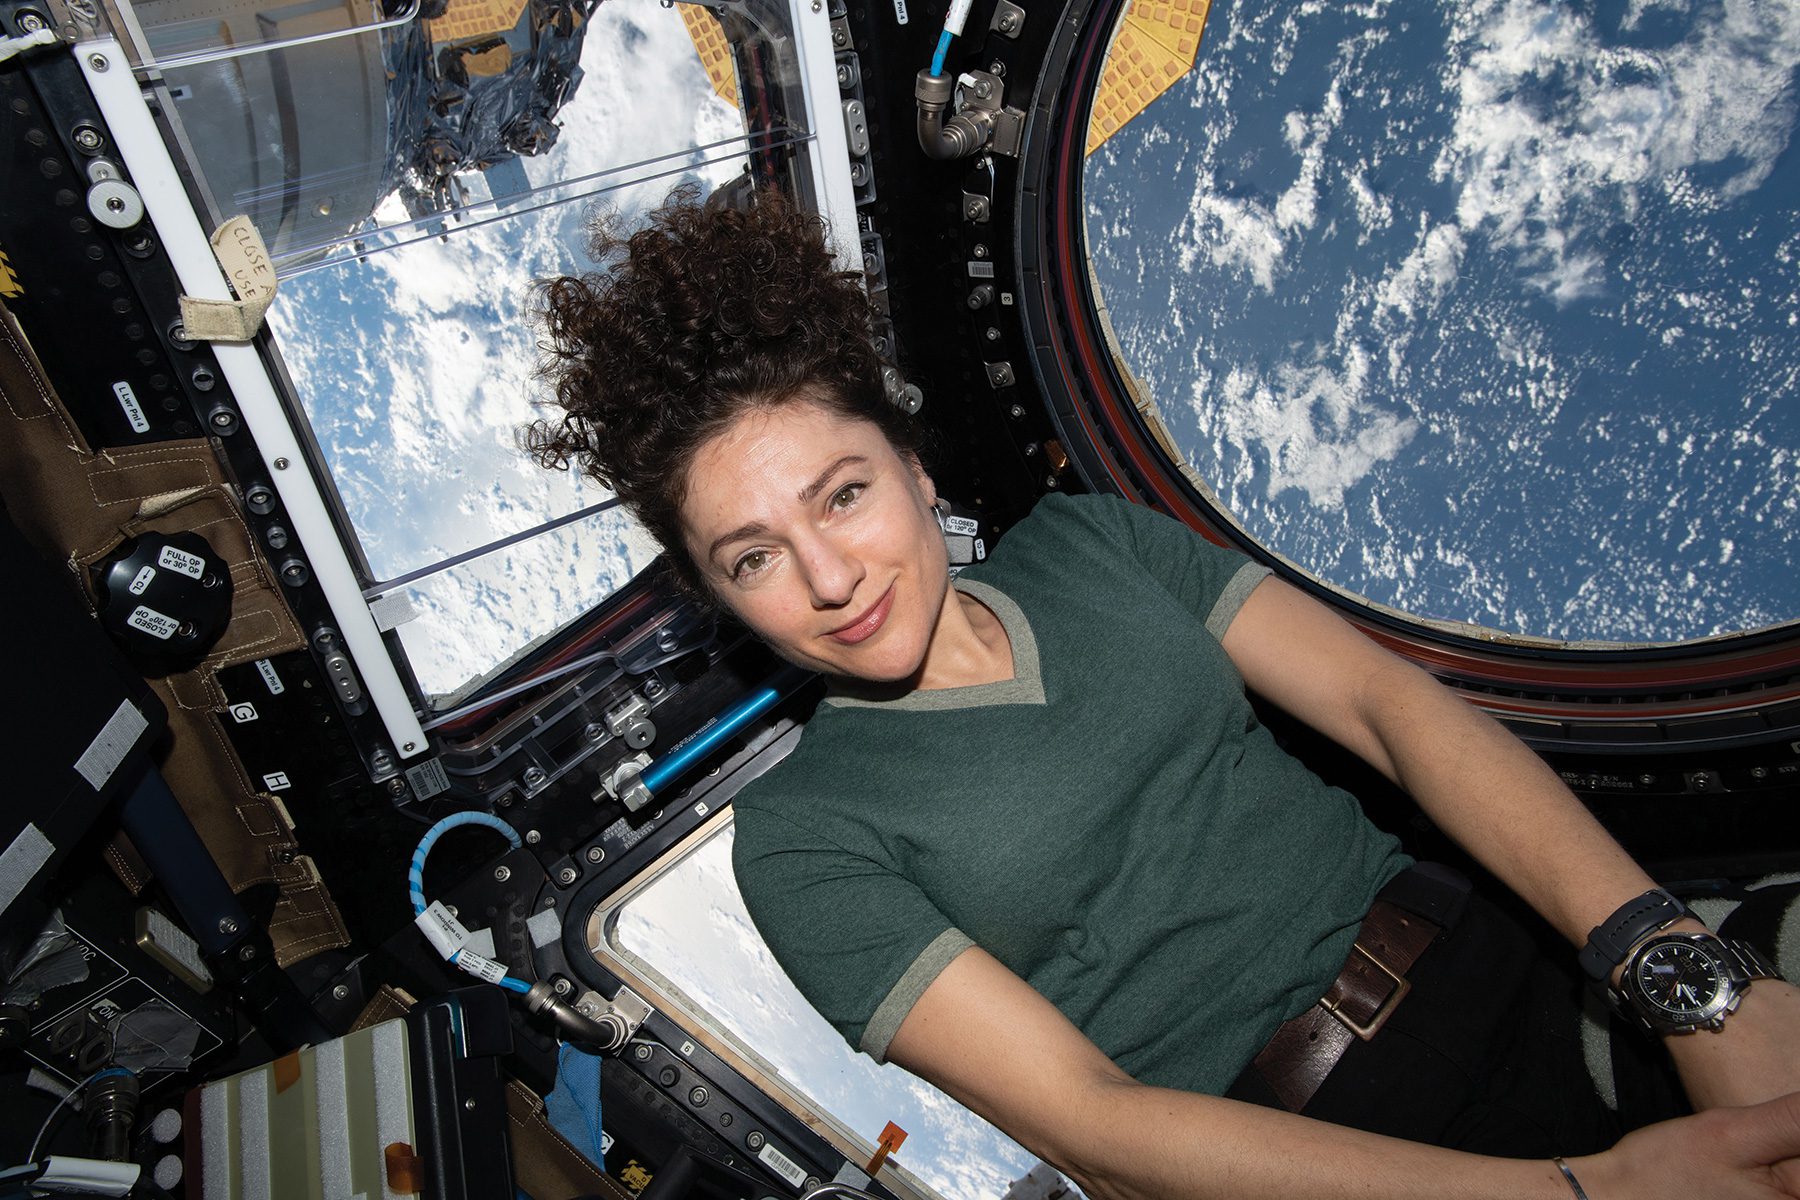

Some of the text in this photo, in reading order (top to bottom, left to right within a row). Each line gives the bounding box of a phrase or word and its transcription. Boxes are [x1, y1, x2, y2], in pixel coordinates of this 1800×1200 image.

[234, 269, 256, 298] USE
[122, 393, 133, 407] Lwr
[130, 408, 141, 421] Pnl
[950, 518, 975, 527] CLOSED
[166, 549, 201, 567] FULL OP
[188, 565, 200, 575] OP
[132, 581, 145, 591] CL
[135, 609, 149, 619] OP
[134, 618, 168, 635] CLOSED
[167, 620, 178, 629] or
[262, 664, 272, 677] Lwr
[267, 675, 278, 688] Pnl
[234, 705, 255, 720] G
[266, 774, 290, 789] H
